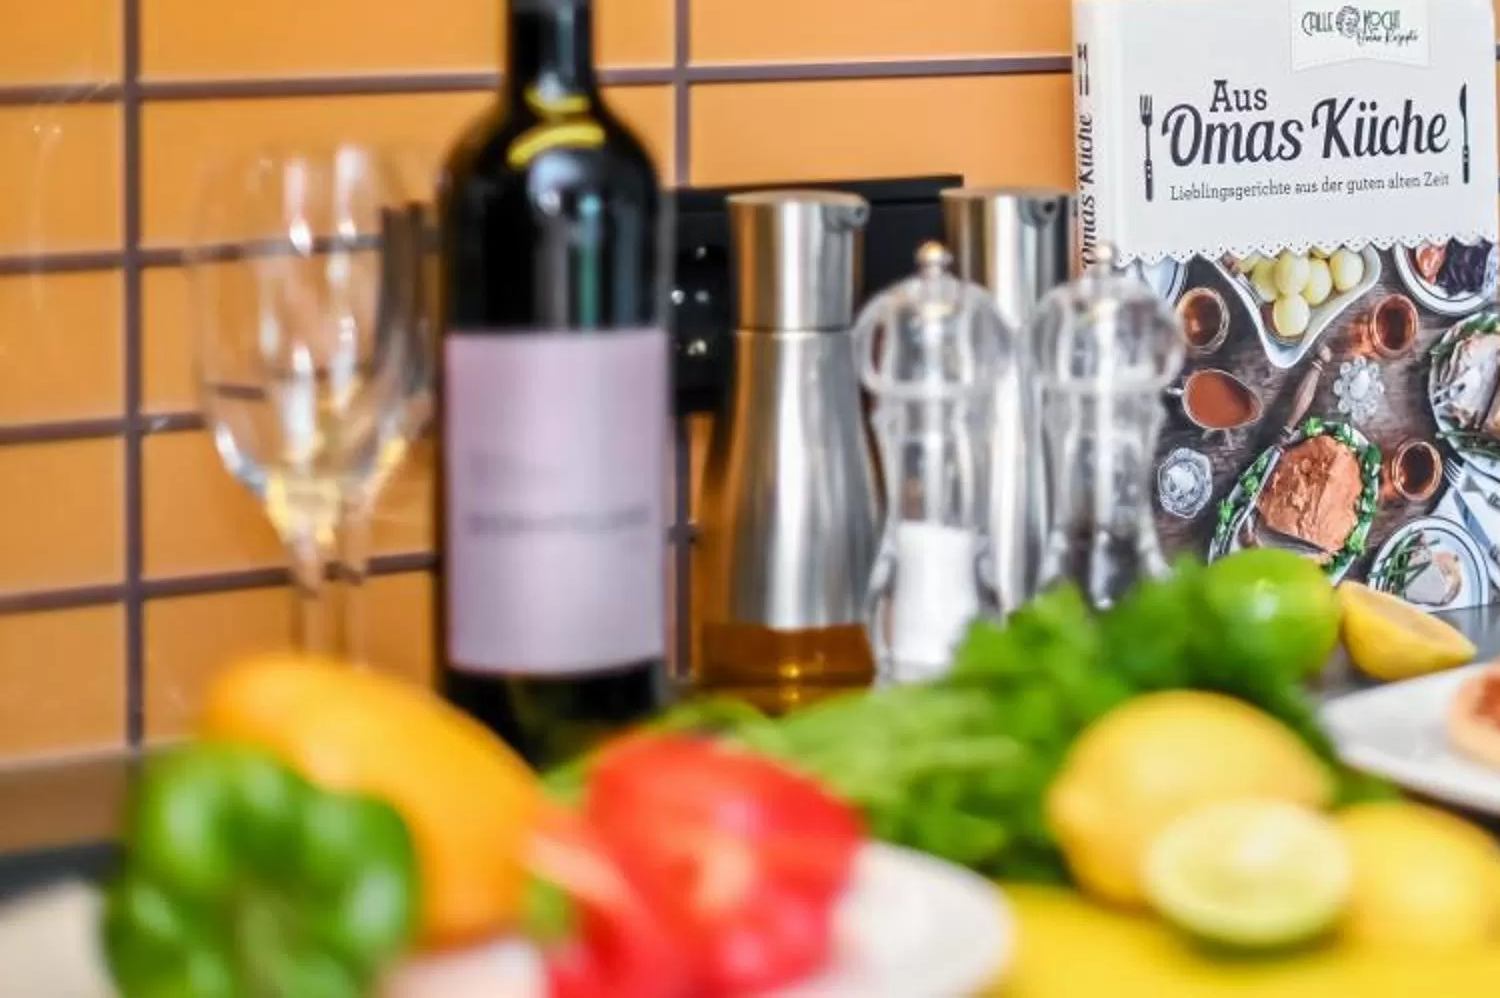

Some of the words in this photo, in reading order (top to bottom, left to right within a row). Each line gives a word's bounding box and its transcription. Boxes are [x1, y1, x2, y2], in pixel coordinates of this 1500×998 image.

[1209, 79, 1268, 112] Aus
[1161, 103, 1304, 167] Omas
[1311, 97, 1450, 159] Küche
[1170, 179, 1291, 202] Lieblingsgerichte
[1295, 181, 1319, 194] aus
[1321, 175, 1343, 193] der
[1347, 177, 1385, 195] guten
[1388, 171, 1421, 189] alten
[1424, 171, 1450, 187] Zeit
